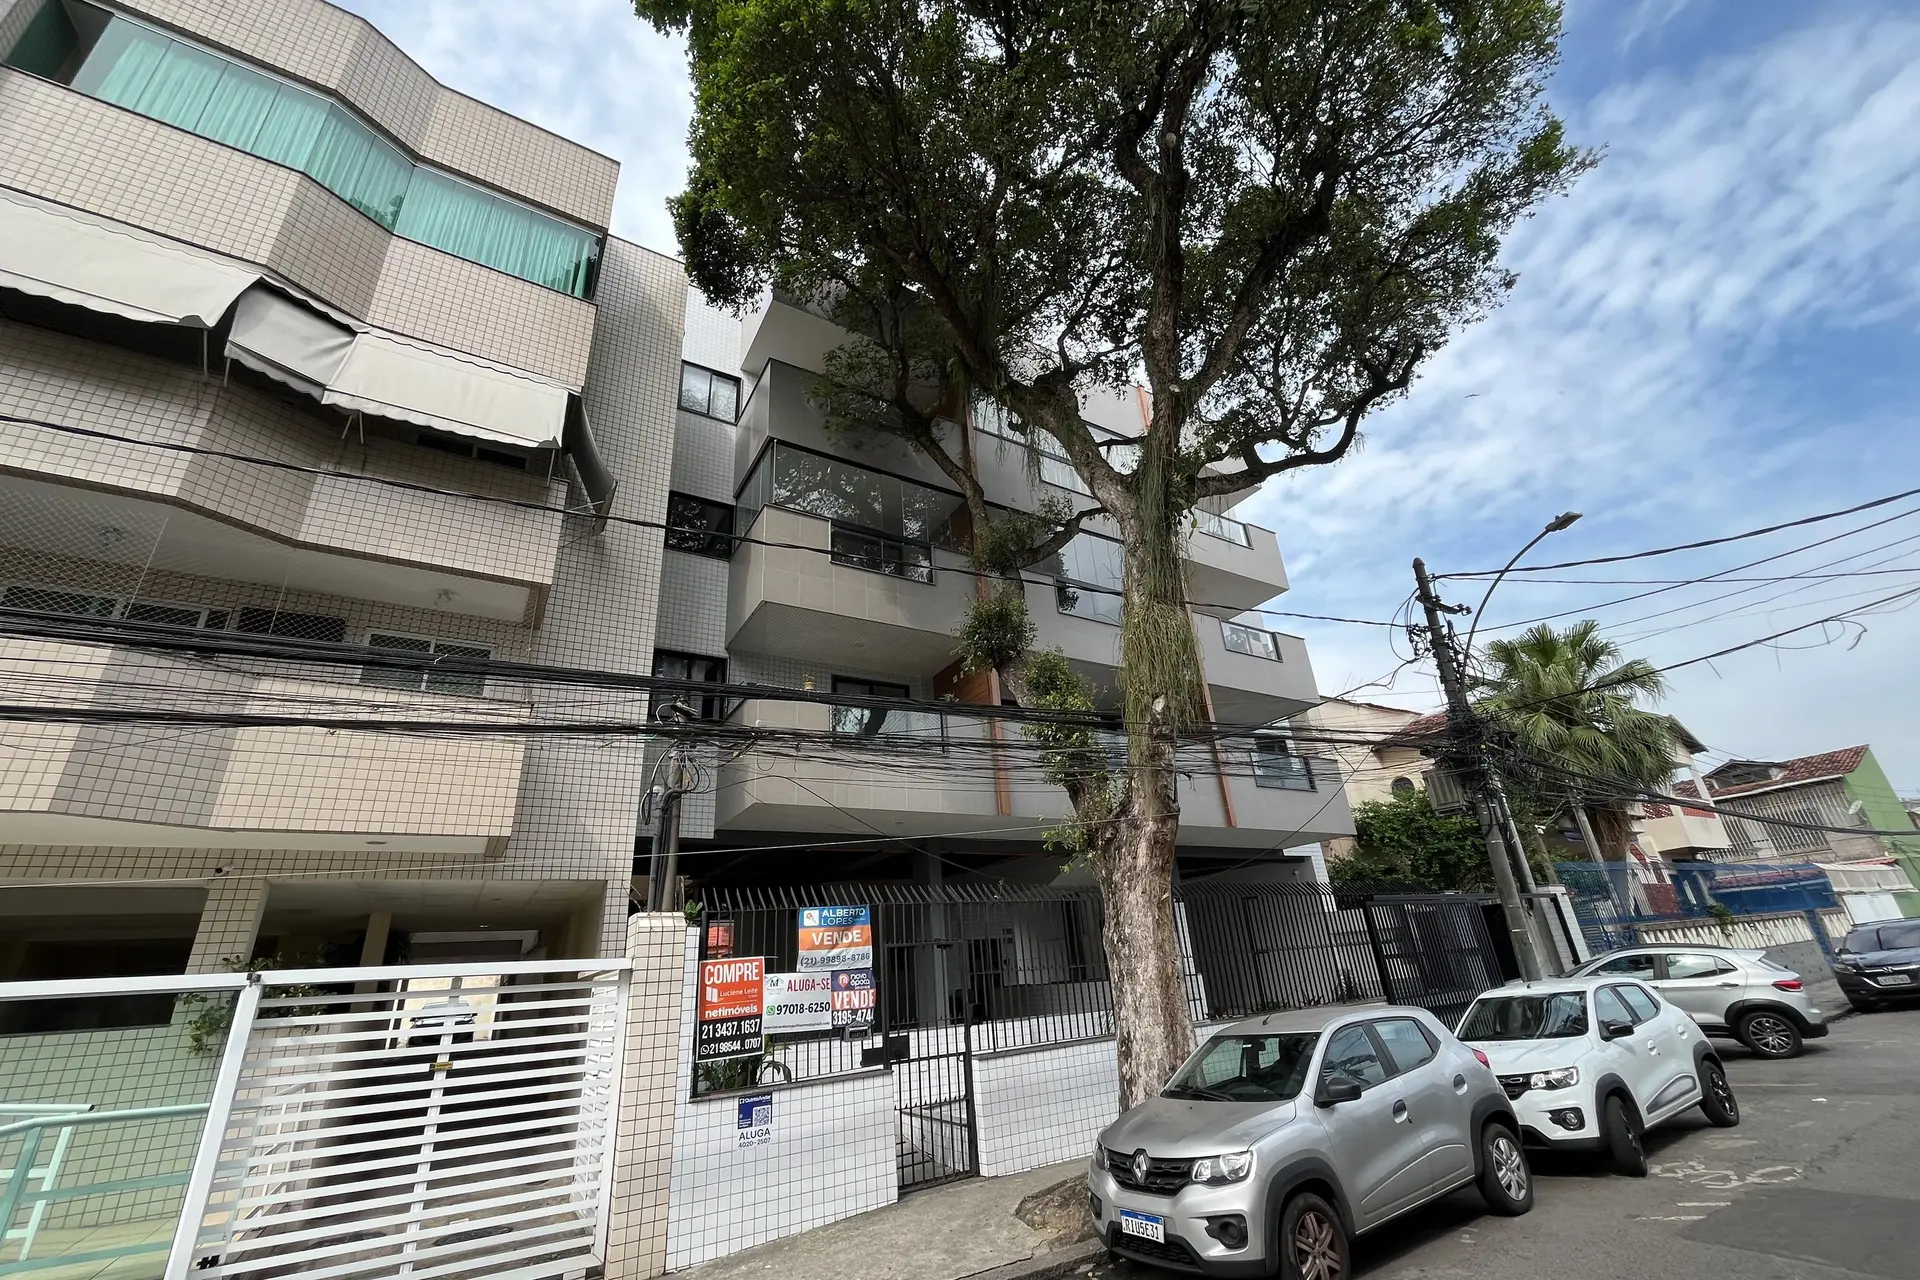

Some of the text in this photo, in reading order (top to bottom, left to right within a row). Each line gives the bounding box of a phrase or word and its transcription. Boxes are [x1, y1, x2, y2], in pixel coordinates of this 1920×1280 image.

[821, 908, 866, 918] ALBERTO
[821, 917, 853, 926] LOPES
[811, 929, 863, 946] VENDE
[800, 956, 817, 967] (21)
[704, 961, 760, 985] COMPRE
[786, 977, 831, 992] ALUGA-SE
[833, 989, 876, 1010] VENDE
[705, 1003, 758, 1019] netimóveis
[776, 1001, 831, 1016] 97018-6250
[702, 1024, 713, 1039] 21
[715, 1018, 760, 1038] 3437.1637
[738, 1127, 771, 1141] ALUGA
